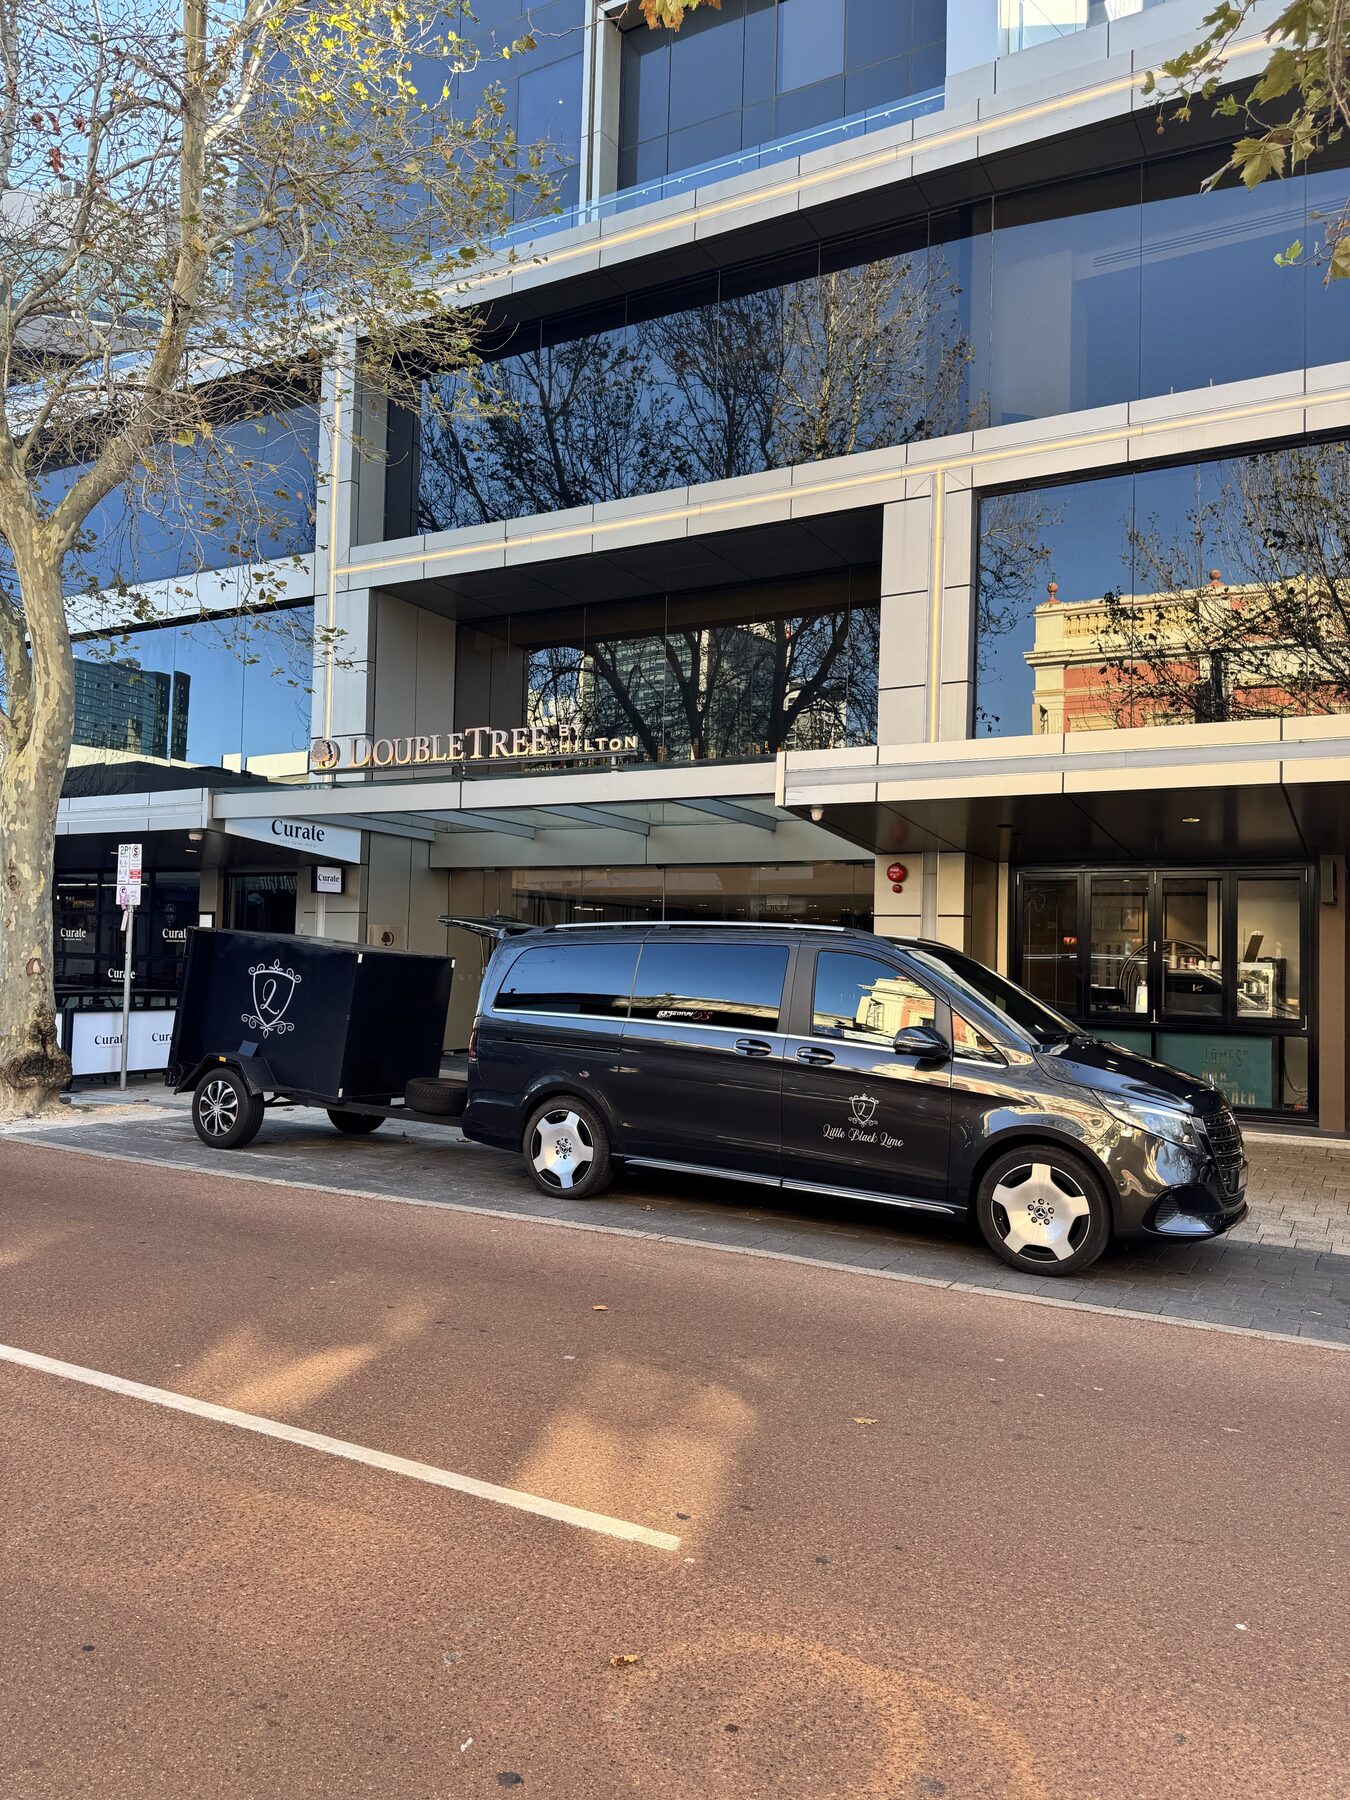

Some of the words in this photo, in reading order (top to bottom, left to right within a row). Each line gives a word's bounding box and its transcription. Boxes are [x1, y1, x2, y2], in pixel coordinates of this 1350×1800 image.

[558, 724, 583, 737] BY
[271, 819, 325, 842] Curate
[317, 873, 340, 883] Curate
[60, 927, 87, 938] Curate
[162, 928, 187, 939] Curat
[94, 1034, 124, 1046] Curat
[822, 1123, 846, 1140] Little
[848, 1127, 878, 1143] Black
